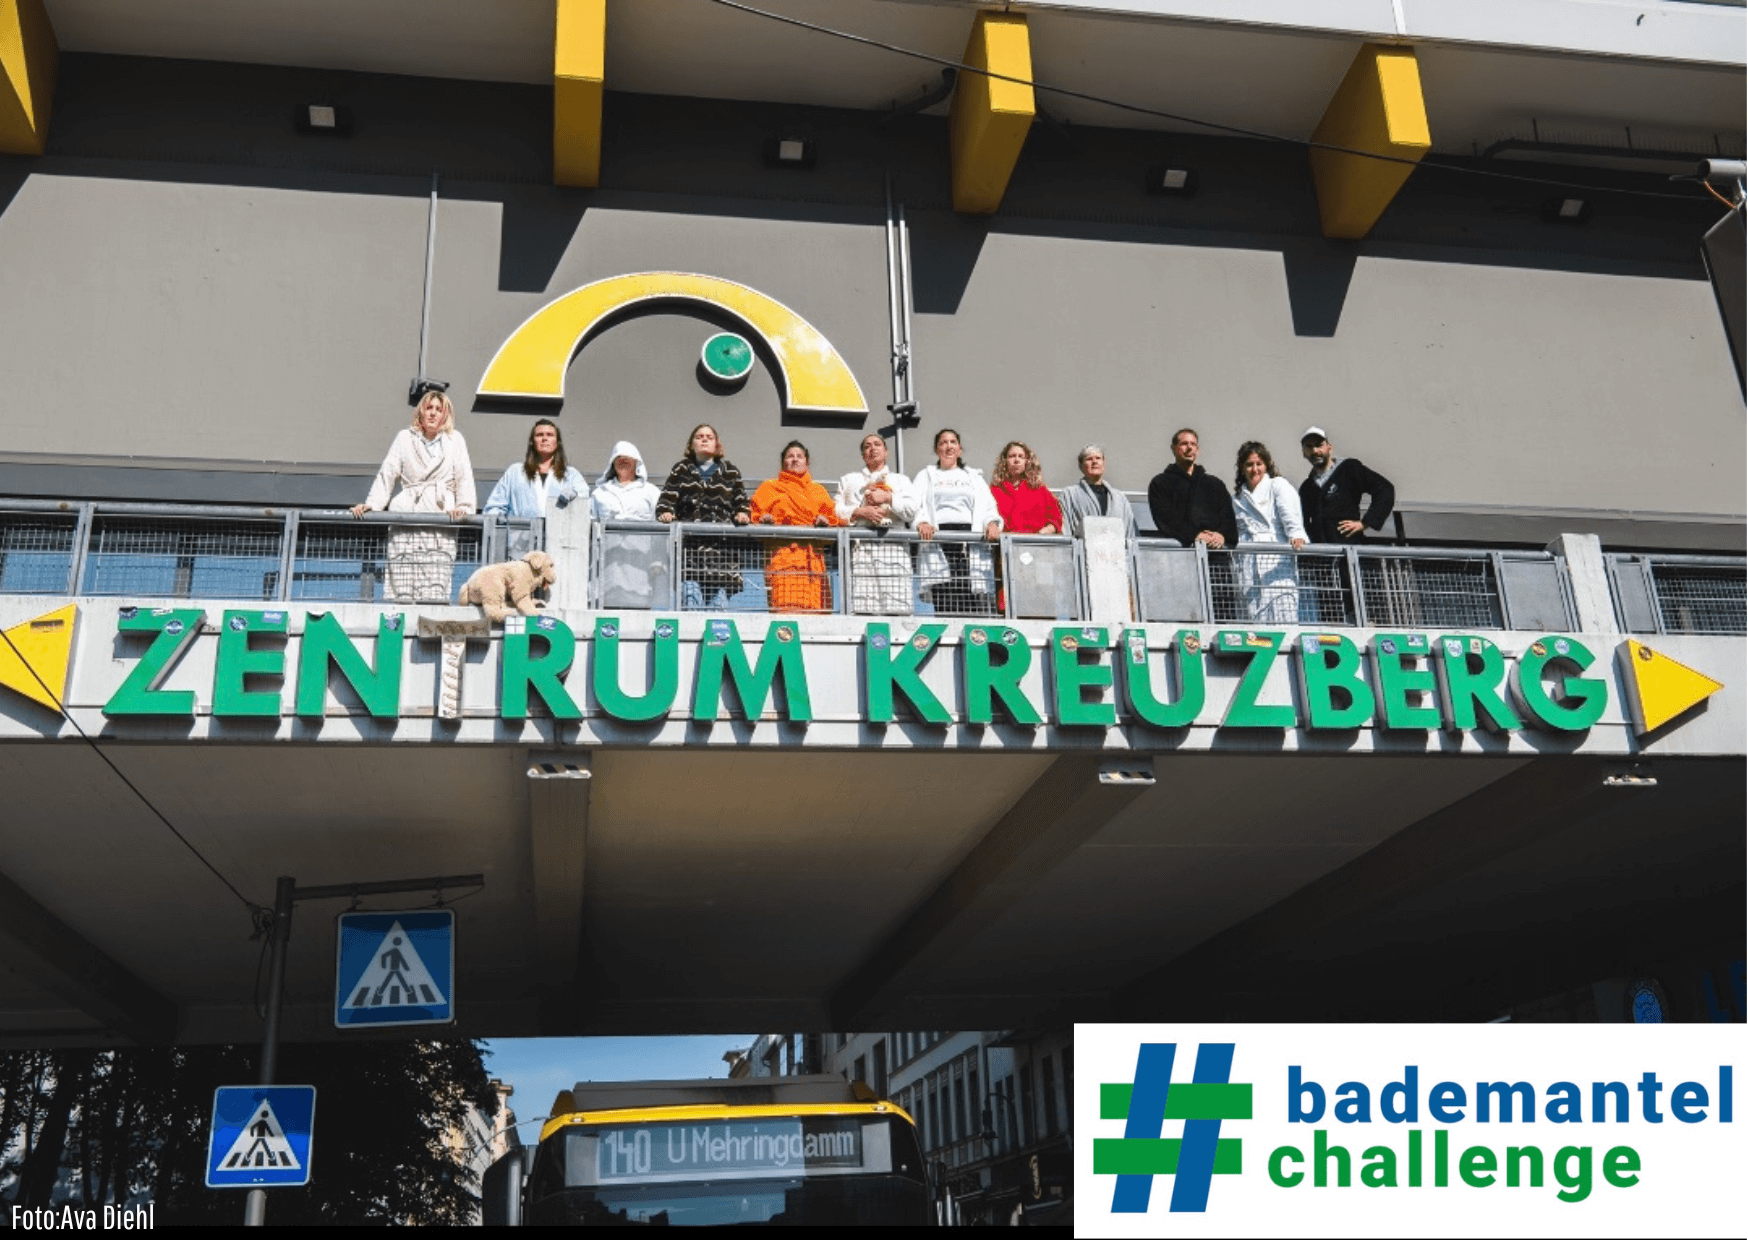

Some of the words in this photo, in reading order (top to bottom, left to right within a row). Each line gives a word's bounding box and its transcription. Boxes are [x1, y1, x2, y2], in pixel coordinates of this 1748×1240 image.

[101, 608, 814, 722] ZENTRUM
[864, 622, 1609, 732] KREUZBERG
[604, 1128, 652, 1174] 140
[666, 1128, 687, 1164] U
[692, 1126, 855, 1167] Mehringdamm
